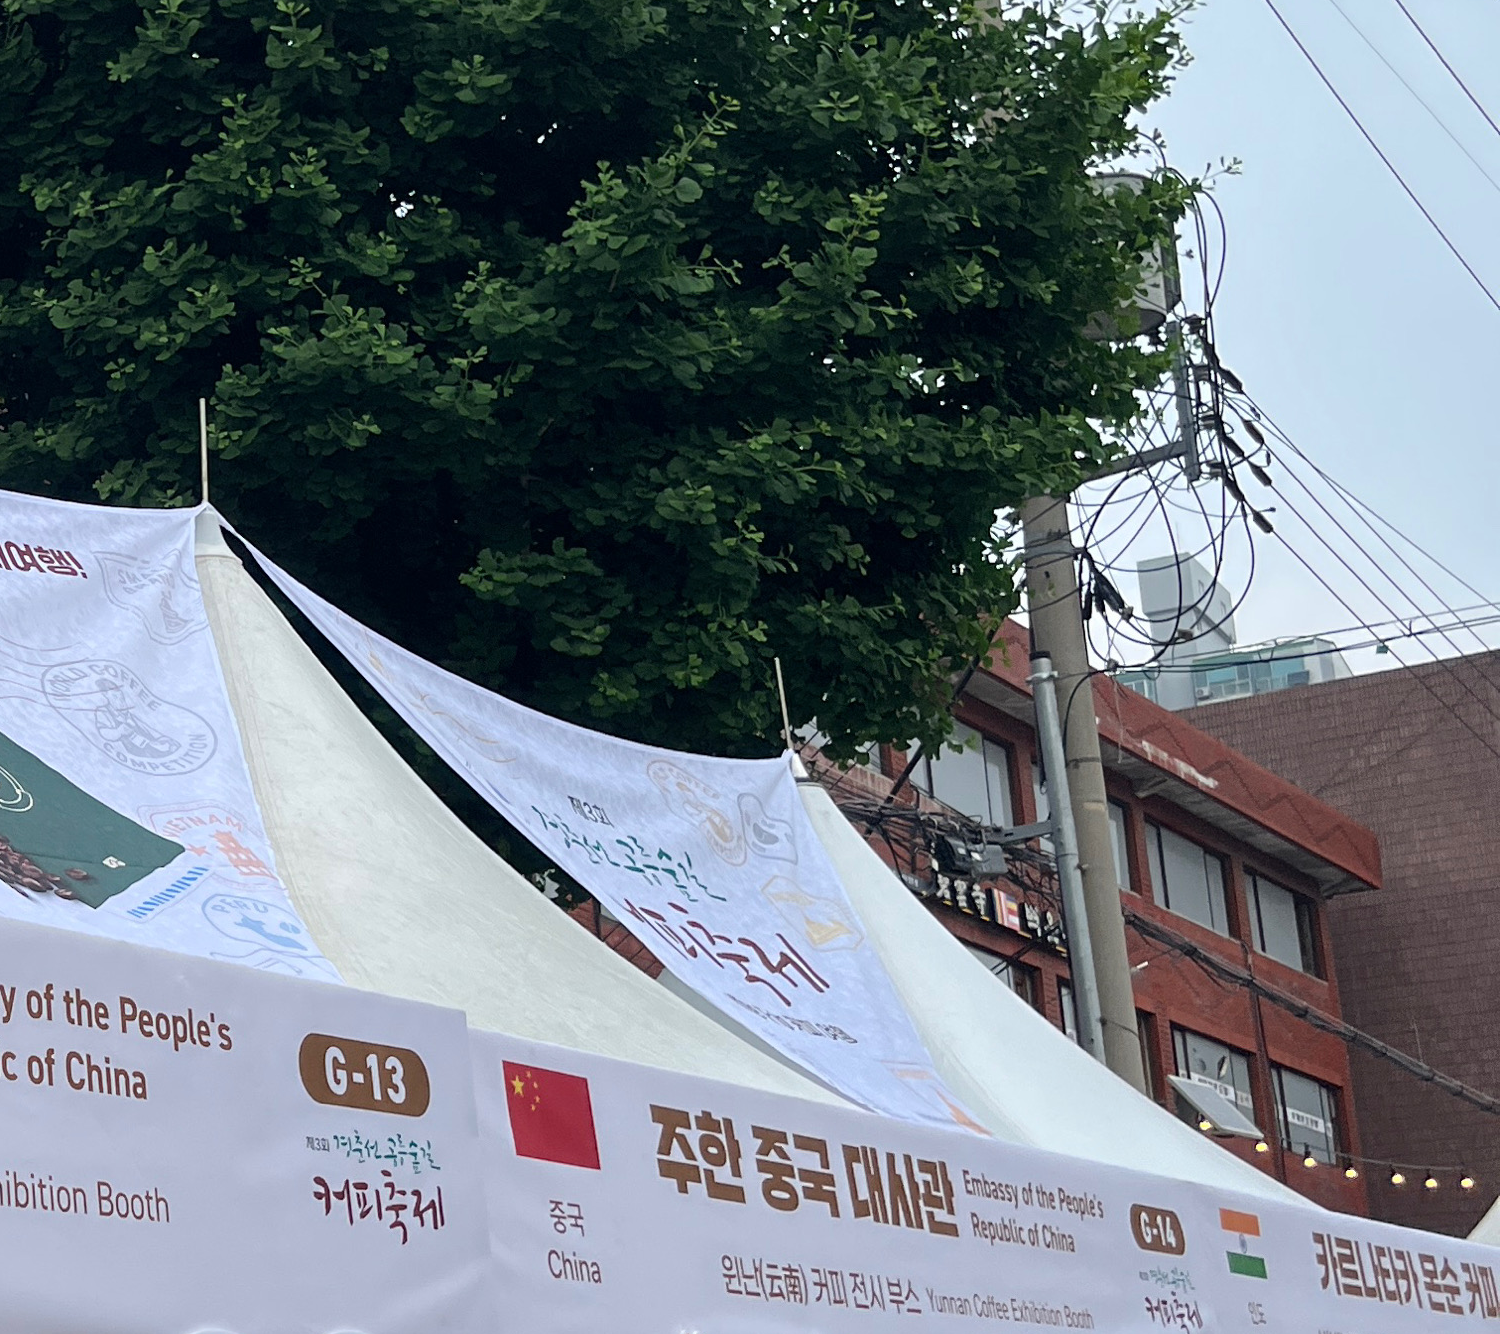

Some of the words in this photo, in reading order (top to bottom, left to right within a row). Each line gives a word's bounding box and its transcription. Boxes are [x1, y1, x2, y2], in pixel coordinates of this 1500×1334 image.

[102, 732, 208, 772] COMPETITION
[211, 898, 269, 915] PERU
[26, 983, 55, 1021] of
[63, 988, 110, 1031] the
[120, 995, 234, 1052] People's
[27, 1047, 55, 1087] of
[65, 1053, 149, 1101] China
[324, 1045, 407, 1105] G-13
[306, 1135, 330, 1153] 제3회
[649, 1103, 746, 1205] 주한
[750, 1124, 841, 1219] 중국
[841, 1143, 960, 1238] 대사관
[97, 1181, 170, 1224] Booth
[313, 1169, 445, 1245] 커피축제
[962, 1168, 1019, 1209] Embassy
[1021, 1181, 1034, 1207] of
[1035, 1184, 1056, 1210] the
[1057, 1186, 1104, 1221] People's
[549, 1199, 585, 1237] 중국
[970, 1211, 1026, 1246] Republic
[1027, 1222, 1040, 1247] of
[1041, 1224, 1076, 1253] China
[1139, 1210, 1177, 1249] G-14
[548, 1249, 602, 1283] China
[721, 1254, 809, 1307] 윈난(云南)
[810, 1267, 849, 1308] 커피
[925, 1286, 973, 1316] Yunnan
[972, 1293, 1010, 1320] Coffee
[1010, 1298, 1065, 1327] Exhibition
[1063, 1305, 1095, 1330] Booth
